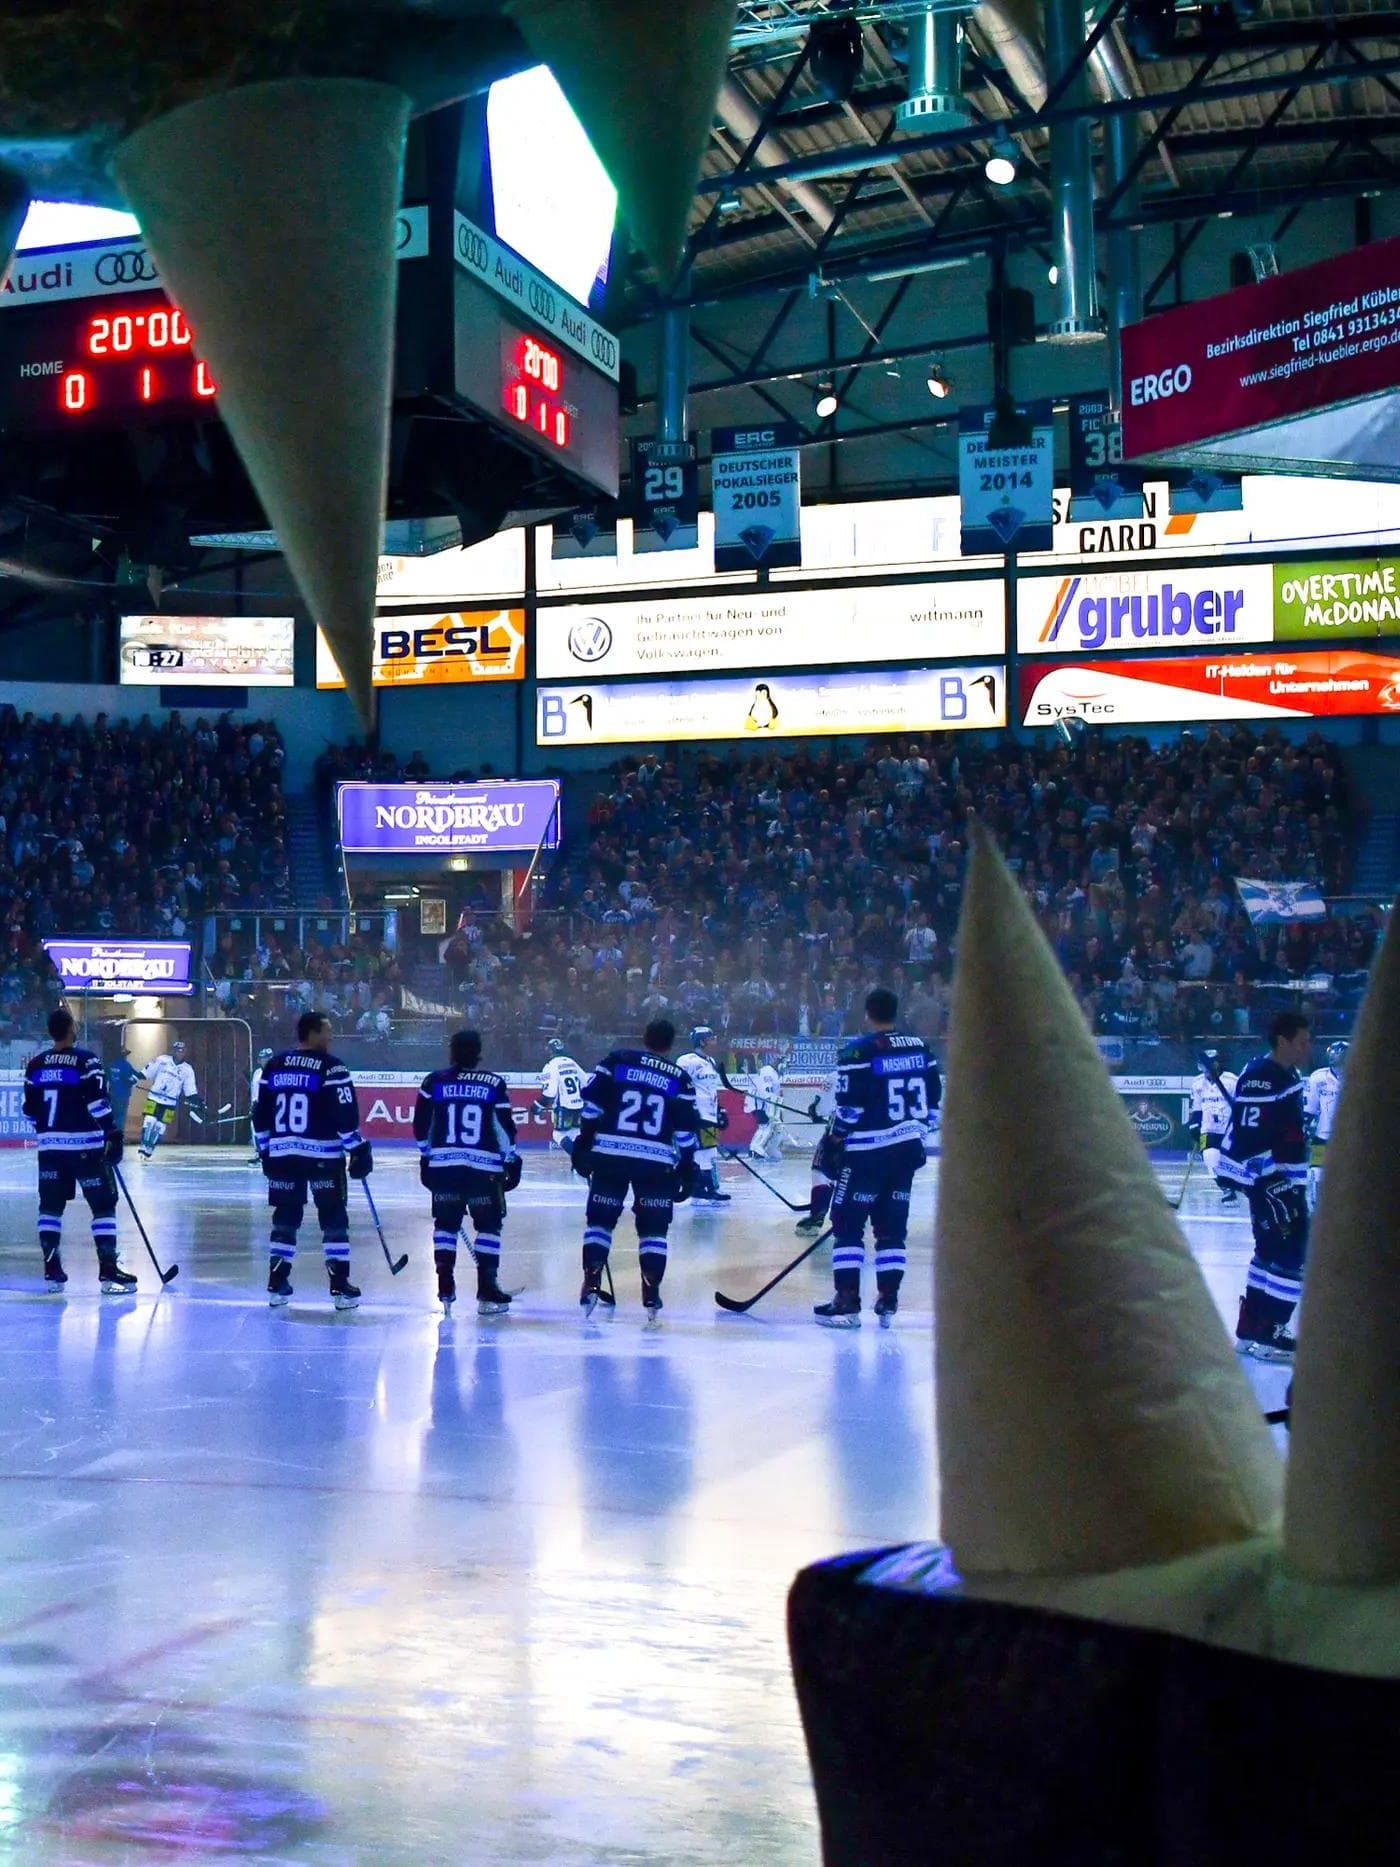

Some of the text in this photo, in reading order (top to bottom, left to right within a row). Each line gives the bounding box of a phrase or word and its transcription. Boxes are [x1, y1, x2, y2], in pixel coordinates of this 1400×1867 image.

[495, 256, 523, 297] Audi
[561, 308, 586, 346] Audi
[1206, 318, 1300, 359] Bezirksdirektion
[1303, 295, 1359, 330] Siegfried
[1292, 335, 1310, 353] Tel
[1313, 325, 1344, 346] 0841
[20, 361, 64, 377] HOME
[65, 374, 86, 409] 0
[143, 369, 151, 399] 1
[1131, 364, 1192, 406] ERGO
[734, 430, 776, 445] ERC
[719, 457, 793, 474] DEUTSCHER
[974, 453, 1039, 469] MEISTER
[644, 466, 684, 501] 29
[714, 472, 798, 490] POKALSIEGER
[980, 472, 1034, 492] 2014
[731, 490, 781, 510] 2005
[1080, 524, 1156, 553] CARD
[1281, 567, 1397, 604] OVERTIME
[910, 607, 984, 623] wittmann
[1078, 584, 1244, 648] gruber
[381, 626, 511, 659] BESL
[757, 626, 783, 637] von
[1037, 702, 1115, 717] SysTec
[375, 803, 525, 833] NORDBRÄU
[415, 834, 489, 845] INGOLSTADT
[889, 1036, 924, 1048] SATURN
[44, 1055, 78, 1066] SATURN
[284, 1055, 322, 1070] SATURN
[640, 1056, 683, 1078] SATURN
[96, 1076, 103, 1089] 7
[457, 1072, 501, 1087] SATURN
[626, 1068, 671, 1090] EDWARDS
[1123, 1079, 1145, 1087] Audi
[337, 1086, 353, 1104] 28
[442, 1084, 489, 1100] KELLEHER
[888, 1077, 928, 1121] 53
[43, 1090, 58, 1127] 7
[274, 1093, 309, 1133] 28
[366, 1099, 415, 1124] Au
[617, 1090, 665, 1136] 23
[1240, 1106, 1261, 1128] 12
[446, 1103, 482, 1145] 19
[835, 1167, 852, 1205] SATURN
